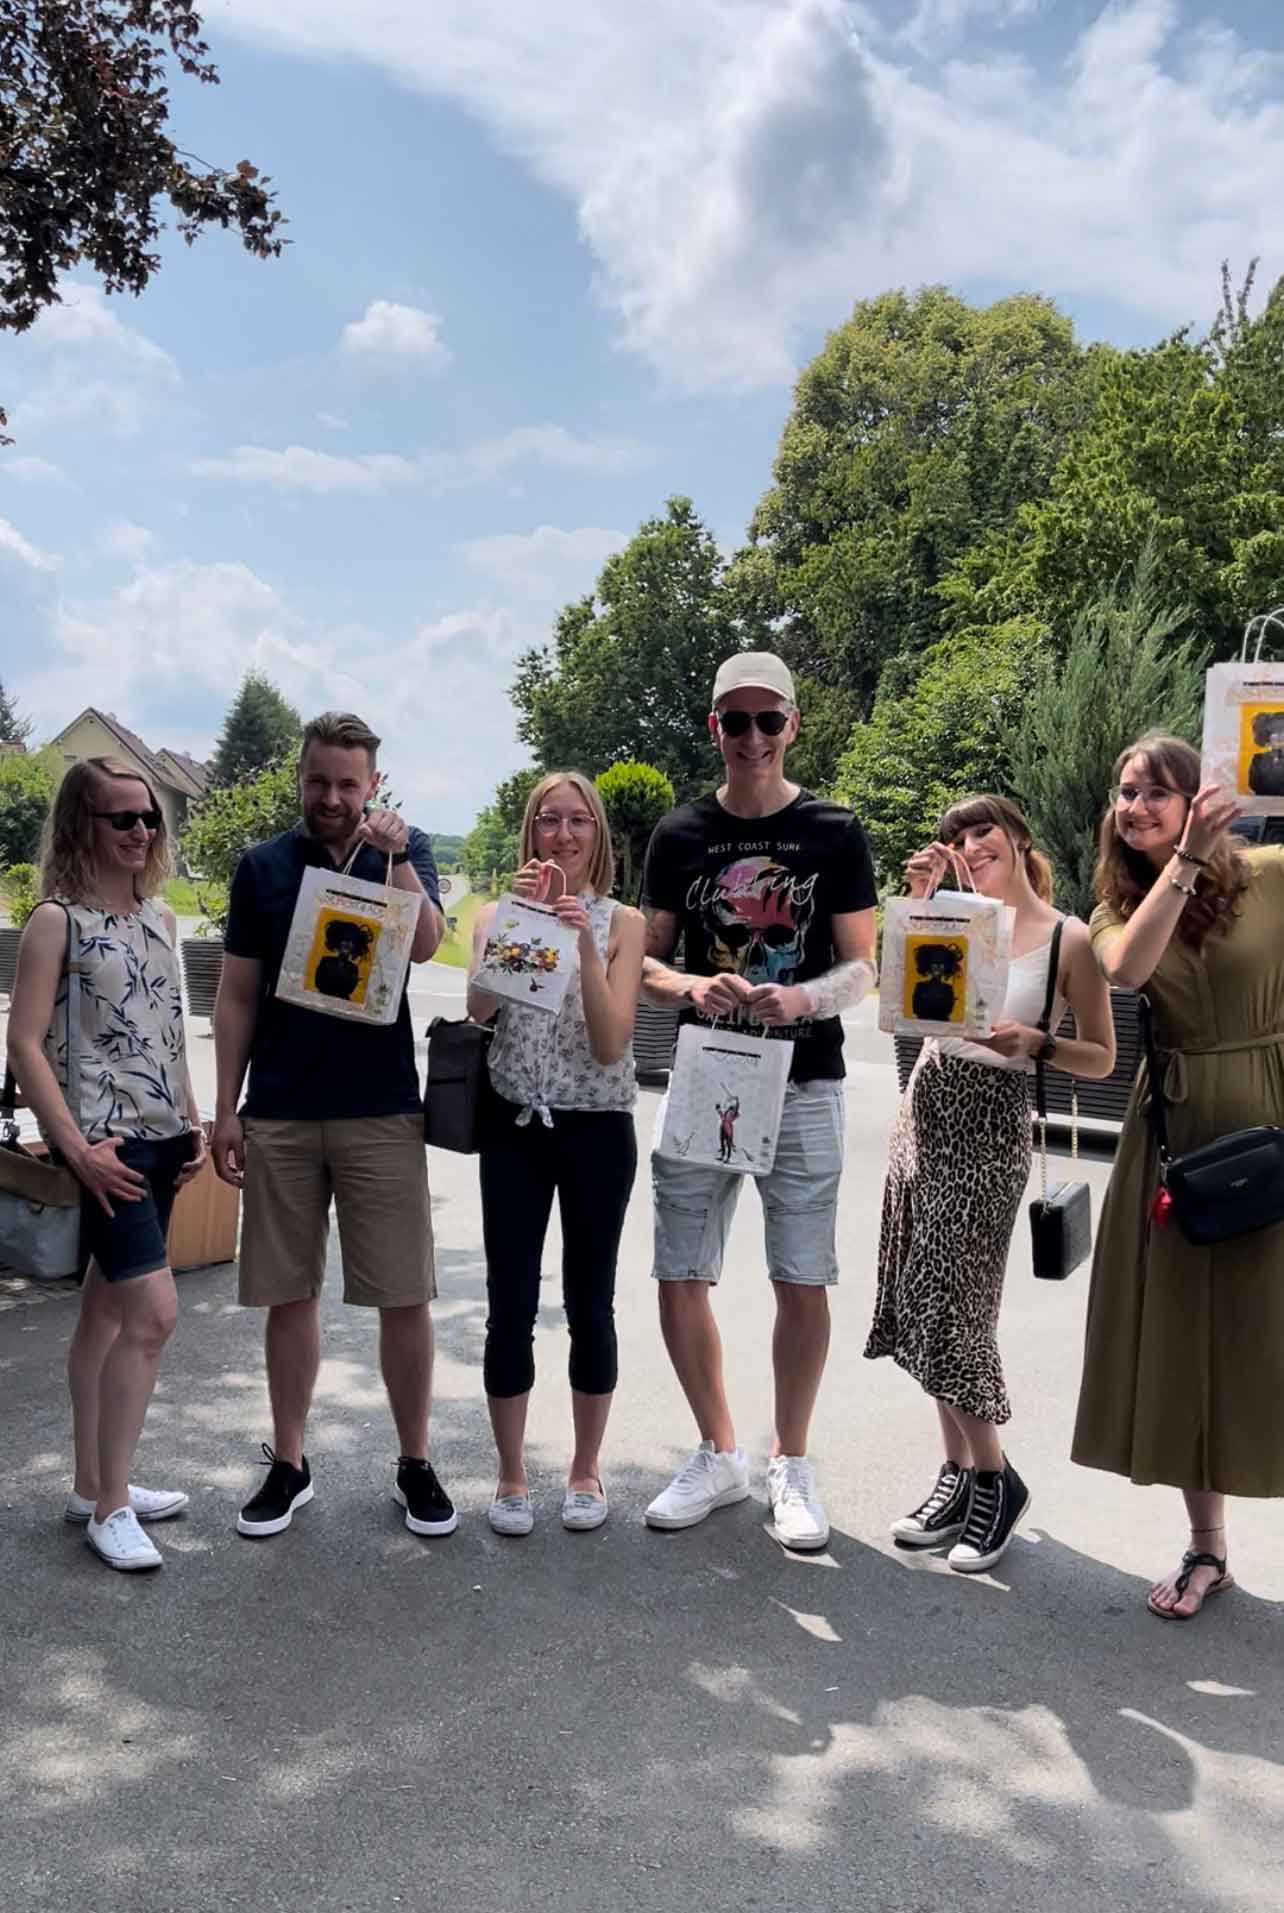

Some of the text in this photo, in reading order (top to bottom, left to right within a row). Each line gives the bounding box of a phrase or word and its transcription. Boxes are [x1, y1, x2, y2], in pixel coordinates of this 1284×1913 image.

[707, 840, 801, 854] WEST COAST SURF
